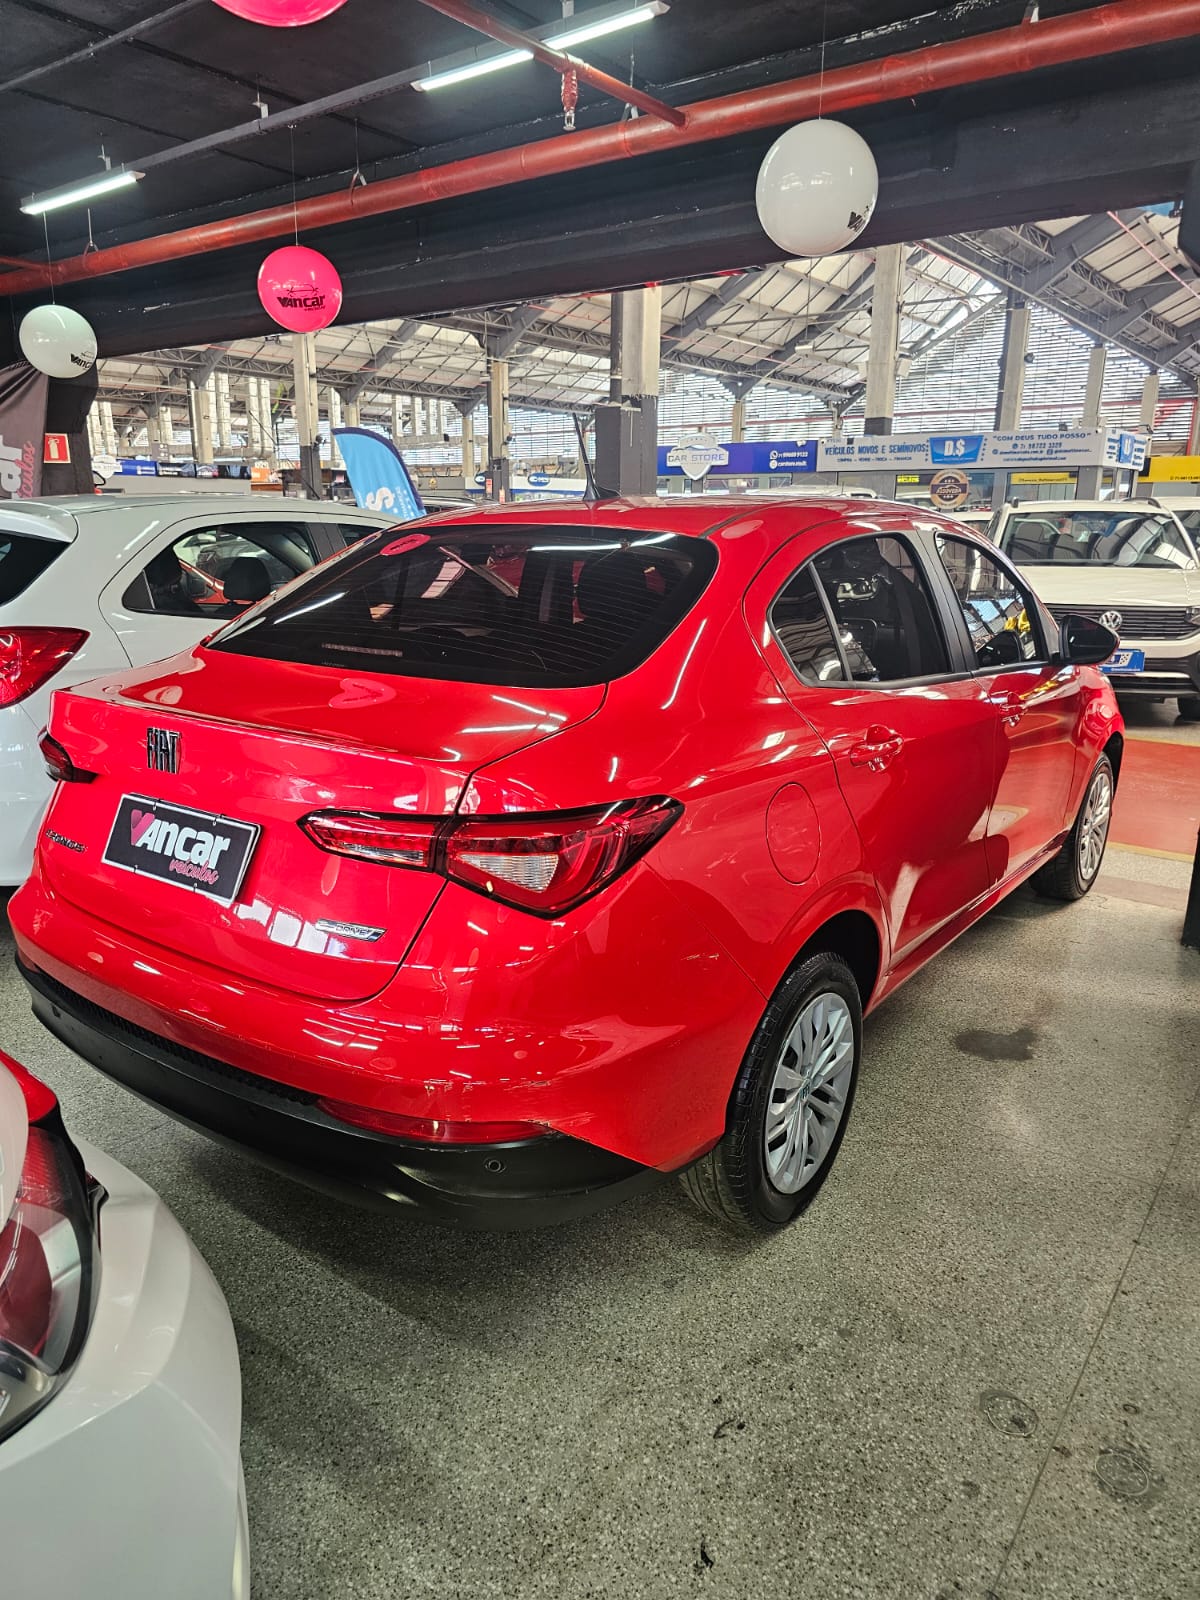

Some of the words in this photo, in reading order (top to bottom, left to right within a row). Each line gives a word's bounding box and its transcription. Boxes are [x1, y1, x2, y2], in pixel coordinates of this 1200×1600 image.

[668, 455, 688, 463] CAR
[691, 453, 725, 462] STORE
[824, 444, 855, 456] VEÍCULOS
[858, 445, 879, 455] NOVOS
[881, 444, 887, 454] E
[0, 434, 22, 499] ar
[146, 727, 181, 774] FIAT
[169, 858, 219, 885] veículos
[335, 924, 372, 936] DRIVE
